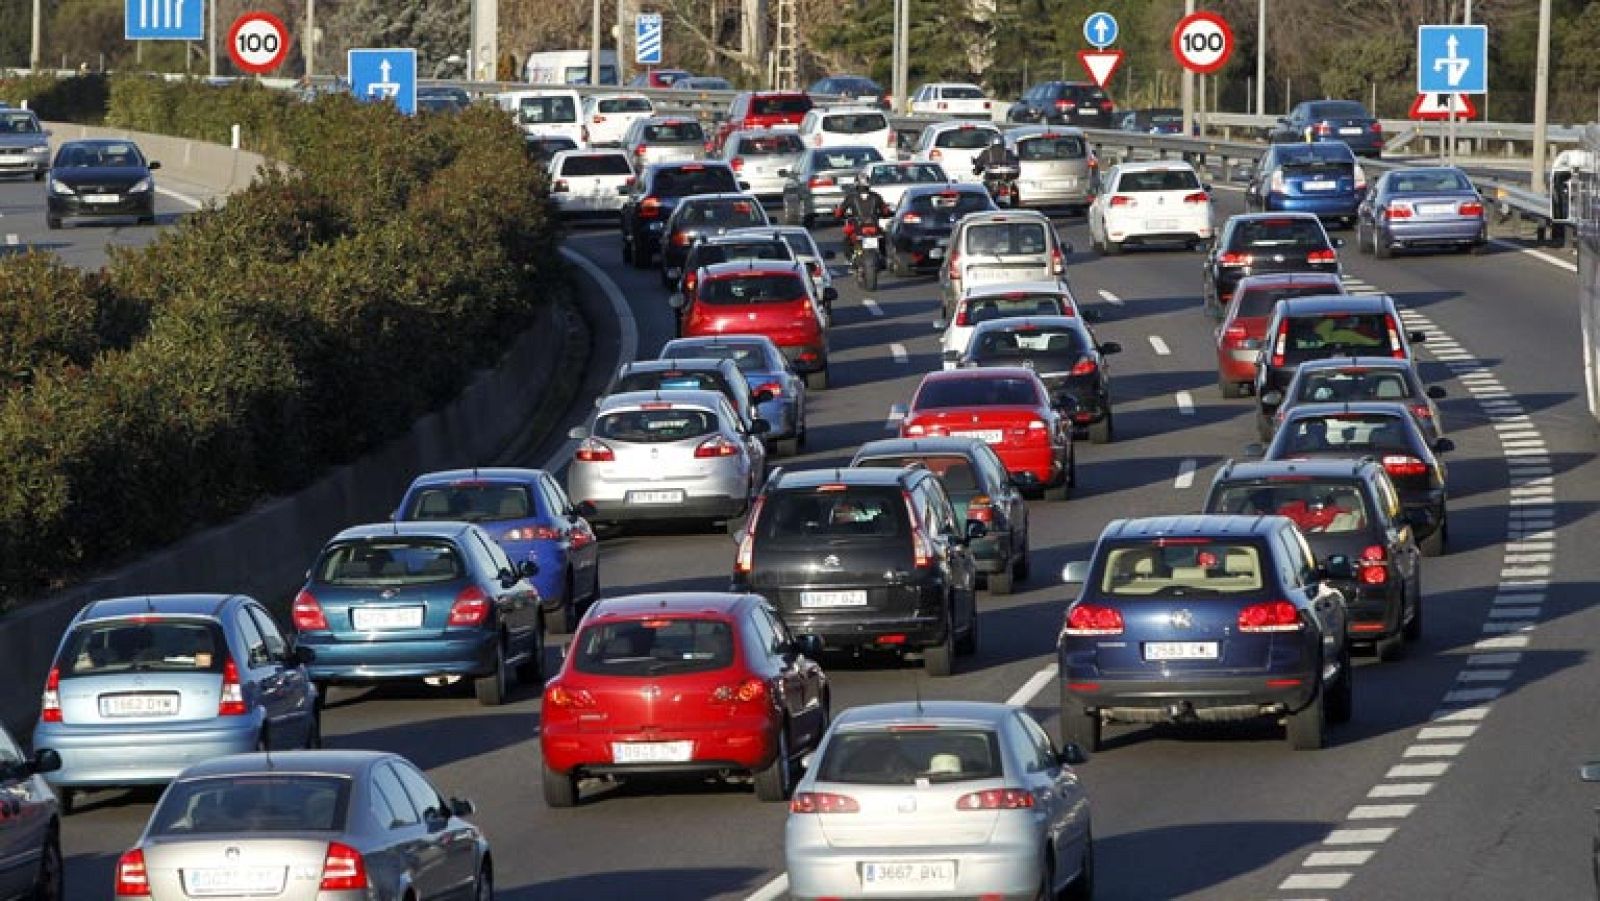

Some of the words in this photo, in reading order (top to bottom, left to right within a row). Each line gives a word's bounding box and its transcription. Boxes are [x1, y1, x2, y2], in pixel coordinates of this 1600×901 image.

[238, 33, 278, 53] 100
[1183, 32, 1224, 52] 100
[877, 864, 914, 880] 3667
